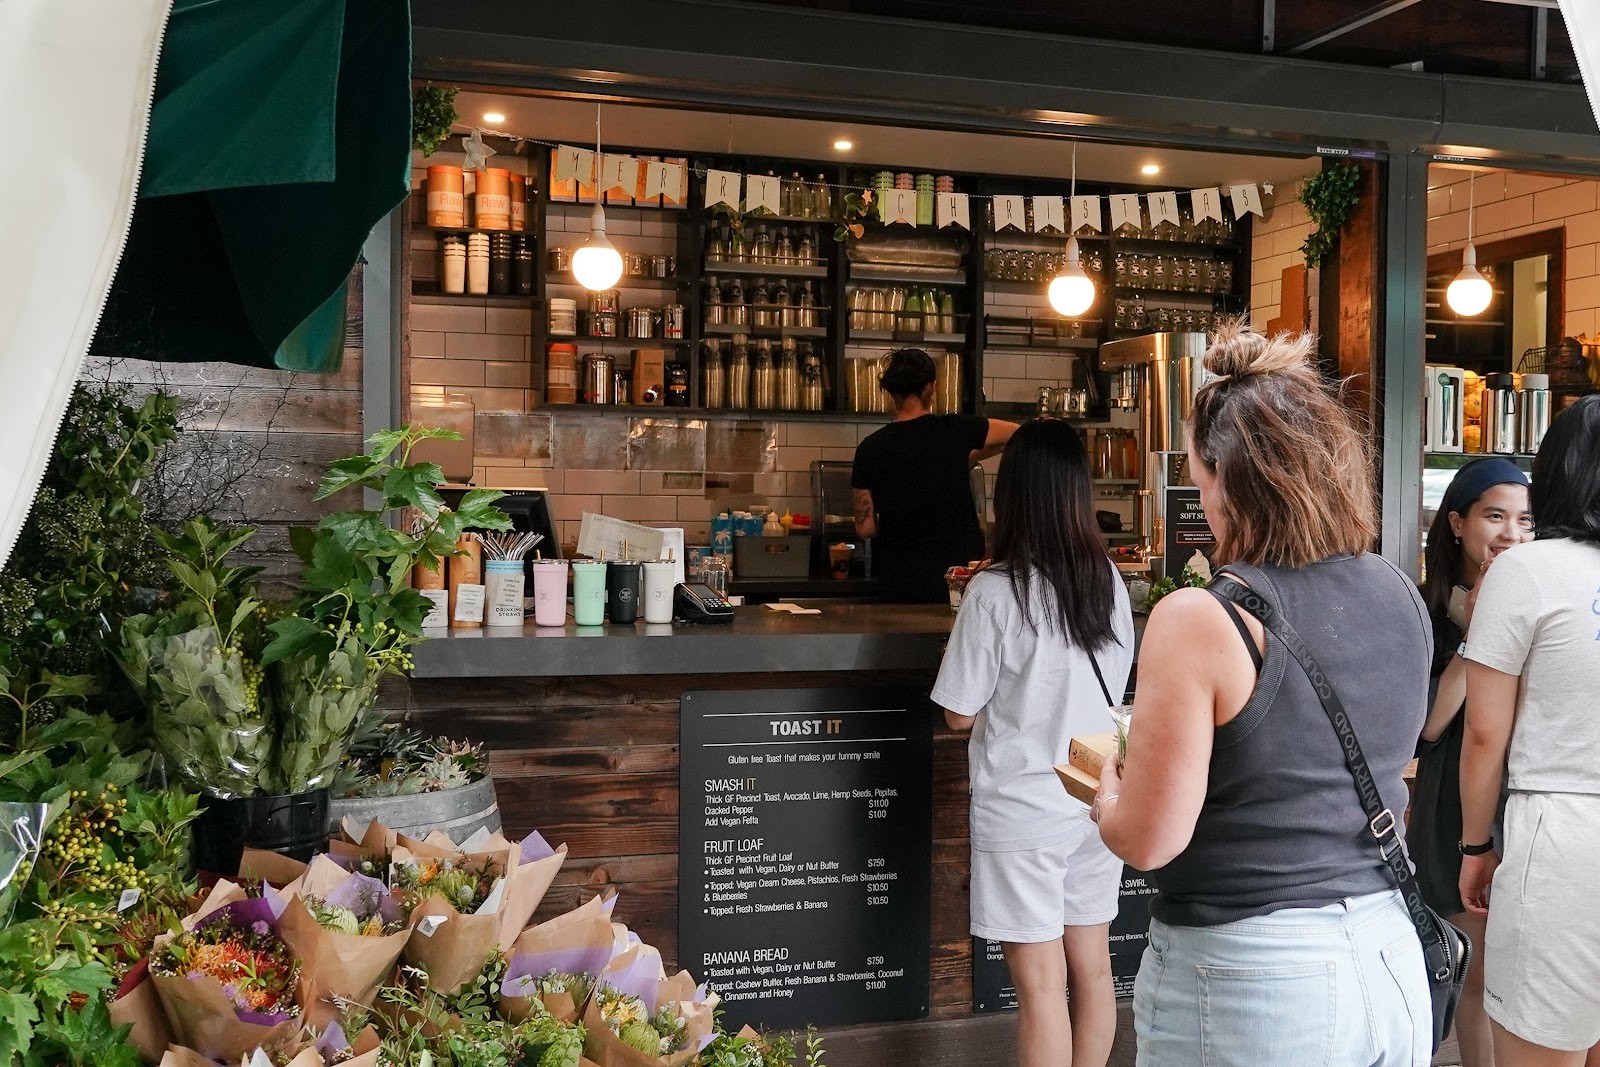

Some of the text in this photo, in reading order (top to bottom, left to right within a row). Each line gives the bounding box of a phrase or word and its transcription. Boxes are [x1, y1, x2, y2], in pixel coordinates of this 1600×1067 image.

[572, 152, 767, 193] MERRY
[481, 197, 505, 208] Raw
[897, 188, 1249, 218] CHRISTMAS
[1180, 512, 1196, 520] SOFT
[1223, 582, 1274, 620] ROAD
[770, 720, 842, 736] TOAST IT
[1335, 711, 1360, 762] ROAD
[728, 751, 880, 764] Gluten free Toast that makes your tummy smile
[705, 778, 756, 792] SMASH IT
[1353, 763, 1380, 818] UNTRY
[705, 795, 722, 804] Thick
[725, 795, 734, 803] GF
[736, 794, 761, 803] Precinct
[832, 790, 850, 800] Hemp
[705, 806, 753, 815] Cracked Pepper
[705, 816, 758, 826] Add Vegan Fetta
[704, 839, 763, 853] FRUIT LOAF
[705, 852, 792, 865] Thick GF Precinct Fruit Loaf
[710, 867, 734, 876] Toasted
[739, 866, 752, 874] with
[779, 864, 795, 873] Dairy
[806, 862, 817, 870] Nut
[820, 861, 839, 870] Butter
[736, 880, 756, 890] Vegan
[759, 878, 779, 888] Cream
[842, 873, 858, 882] Fresh
[860, 872, 897, 882] Strawberries
[867, 883, 888, 892] $10.50
[1125, 879, 1147, 888] SWIRL
[704, 891, 747, 901] & Blueberries
[867, 896, 888, 906] $10.50
[736, 905, 753, 913] Fresh
[755, 902, 794, 912] Strawberries
[804, 901, 828, 909] Banana
[1408, 892, 1432, 935] ROAD
[704, 948, 788, 965] BANANA BREAD
[710, 968, 734, 977] Toasted
[736, 967, 750, 975] with
[776, 964, 792, 974] Dairy
[803, 962, 815, 971] Nut
[817, 961, 836, 969] Butter
[736, 980, 760, 989] Cashew
[785, 977, 801, 985] Fresh
[804, 975, 827, 984] Banana
[878, 968, 903, 978] Coconut
[725, 991, 757, 1001] Cinnamon
[760, 990, 772, 999] and
[773, 988, 793, 998] Honey
